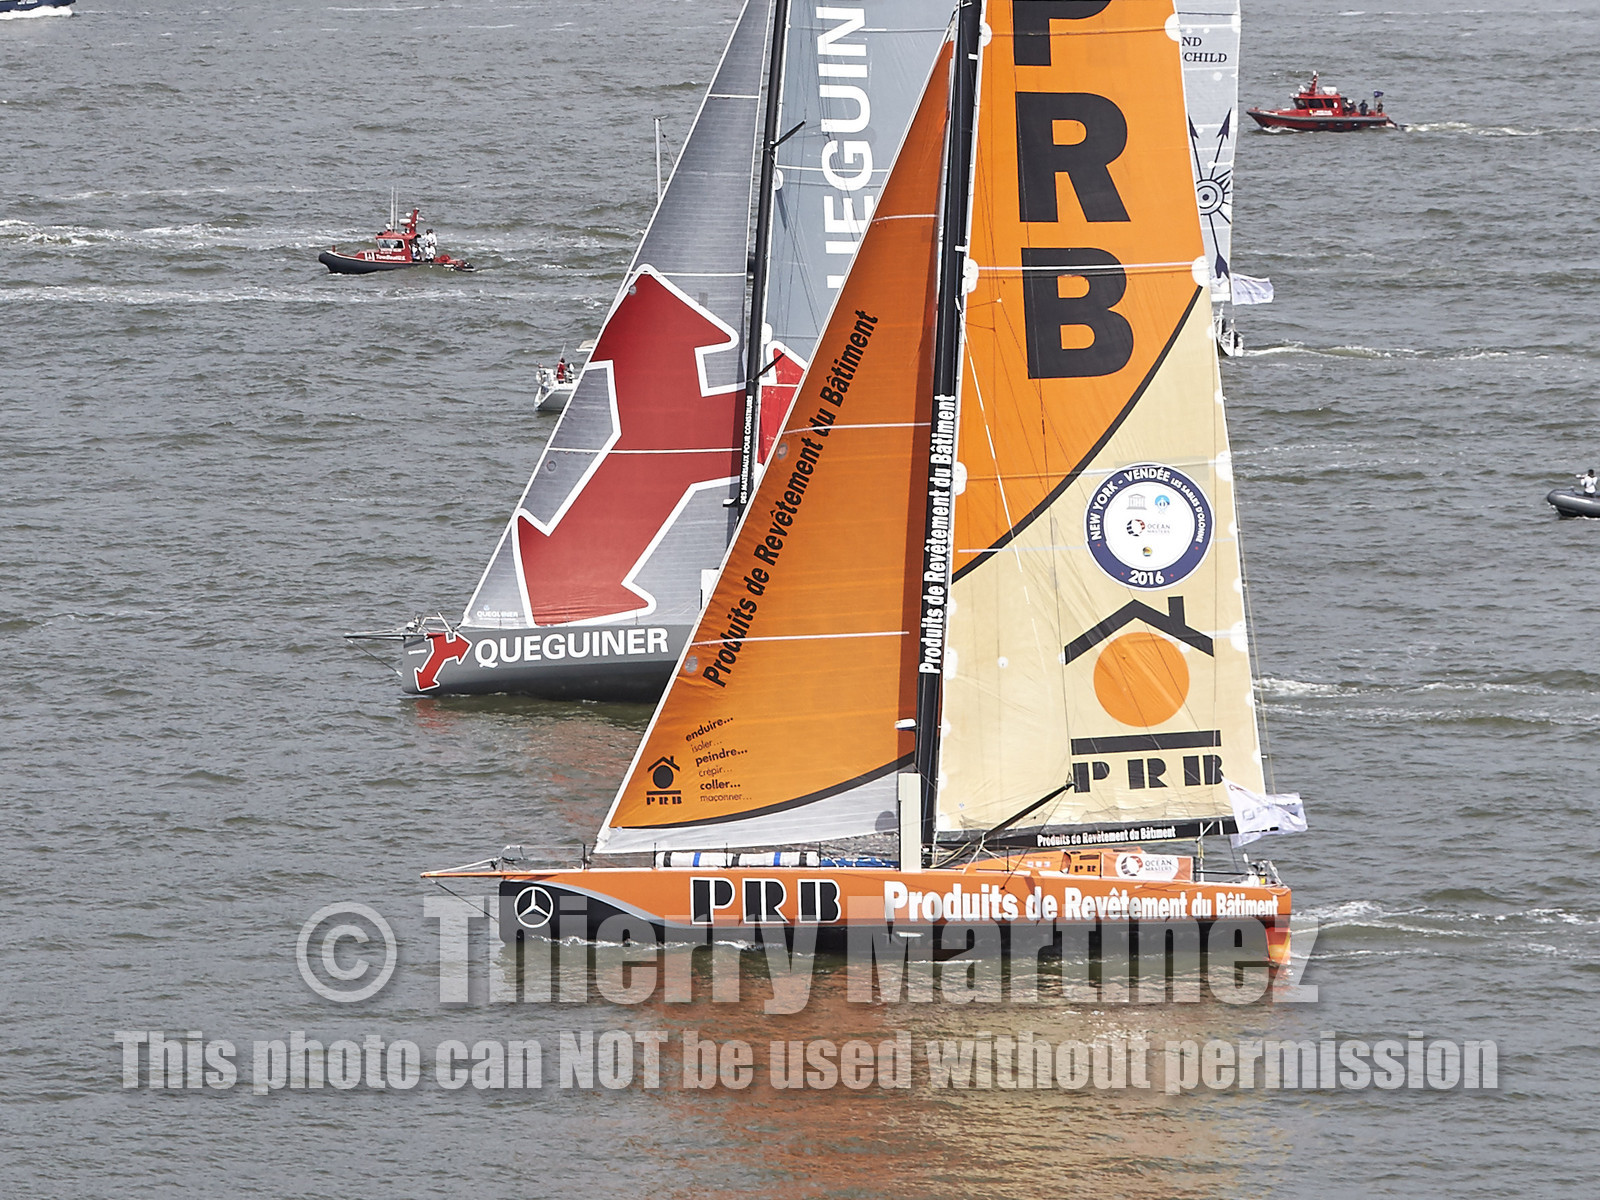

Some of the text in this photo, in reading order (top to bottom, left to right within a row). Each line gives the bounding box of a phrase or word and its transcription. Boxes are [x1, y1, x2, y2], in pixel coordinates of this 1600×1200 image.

[1123, 467, 1171, 482] VENDÉE
[703, 309, 879, 688] Produits de Revêtement du Bâtiment
[1093, 481, 1118, 510] YORK
[919, 394, 956, 674] Produits de Revêtement du Bâtiment
[1090, 513, 1102, 540] NEW
[1128, 570, 1164, 585] 2016
[474, 628, 669, 668] QUEGUINER
[1072, 754, 1224, 794] PRB
[646, 796, 682, 805] PRB
[1037, 834, 1071, 847] Produits
[1140, 826, 1176, 840] Bâtiment
[690, 877, 842, 925] PRB
[884, 880, 1279, 922] Produits de Revêtement du Bâtiment
